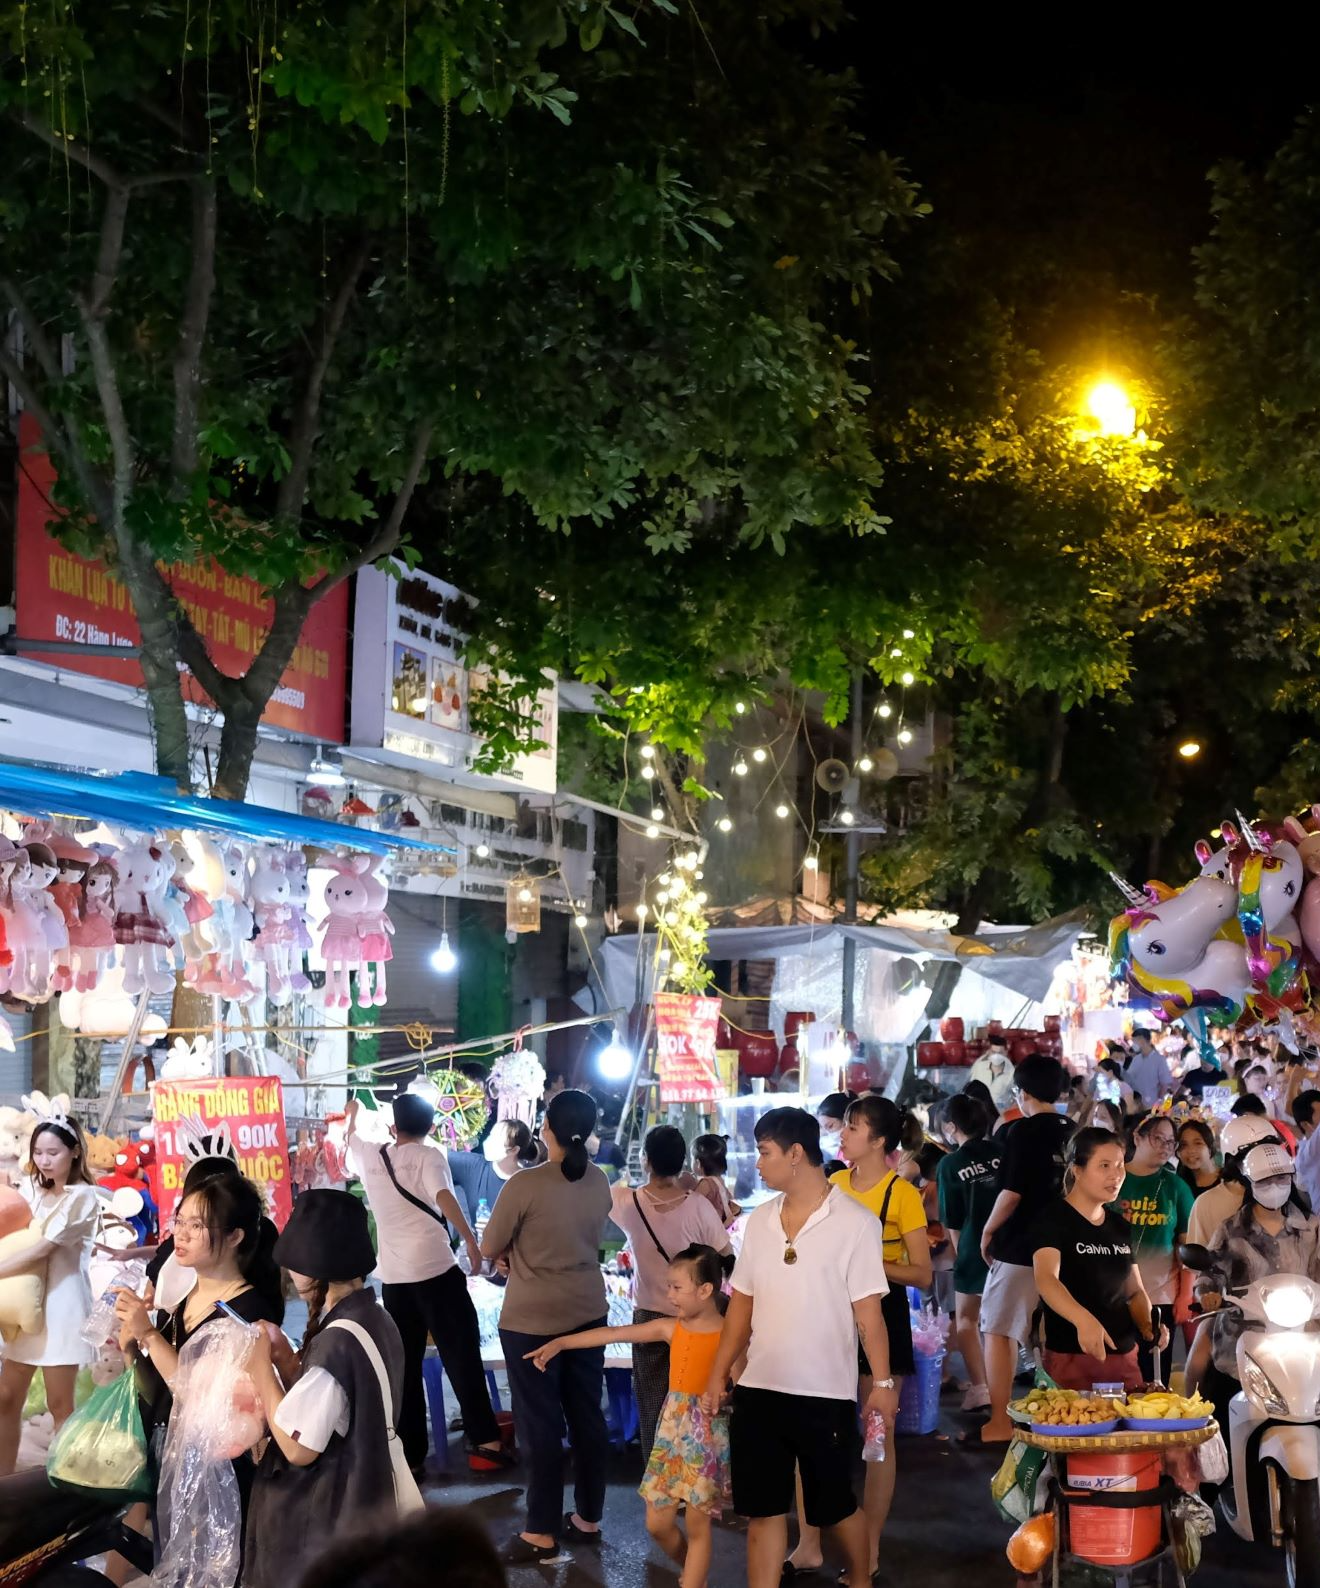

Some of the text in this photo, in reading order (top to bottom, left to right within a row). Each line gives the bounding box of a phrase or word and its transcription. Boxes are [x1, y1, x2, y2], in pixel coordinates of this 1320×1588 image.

[74, 620, 86, 644] 22
[156, 1086, 201, 1122] HÀNG
[253, 1081, 281, 1115] GIÁ
[238, 1122, 280, 1150] 90K
[1120, 1196, 1157, 1211] ouis
[1076, 1242, 1111, 1255] Calvin
[1095, 1478, 1114, 1488] XT
